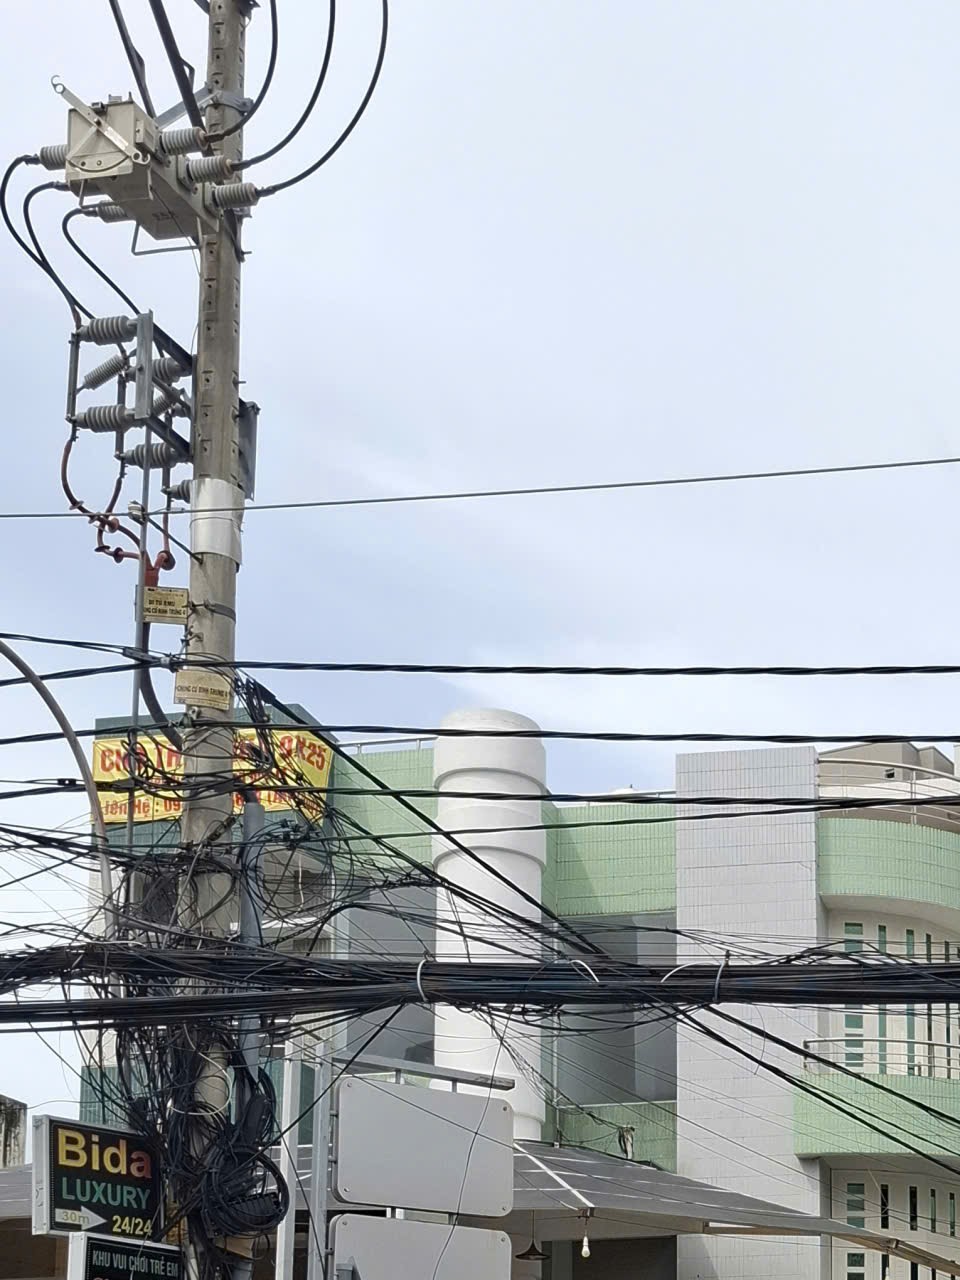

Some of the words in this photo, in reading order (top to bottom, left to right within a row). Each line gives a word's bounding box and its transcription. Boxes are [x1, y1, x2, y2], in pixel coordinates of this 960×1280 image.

[58, 1128, 152, 1179] Bida
[62, 1177, 151, 1210] LUXURY
[62, 1210, 90, 1226] 30m
[112, 1215, 153, 1237] 24/24
[92, 1250, 111, 1268] KHU
[112, 1252, 127, 1270] VUI
[128, 1255, 149, 1273] CHƠI
[150, 1255, 166, 1276] TRẺ
[166, 1261, 179, 1277] EM
